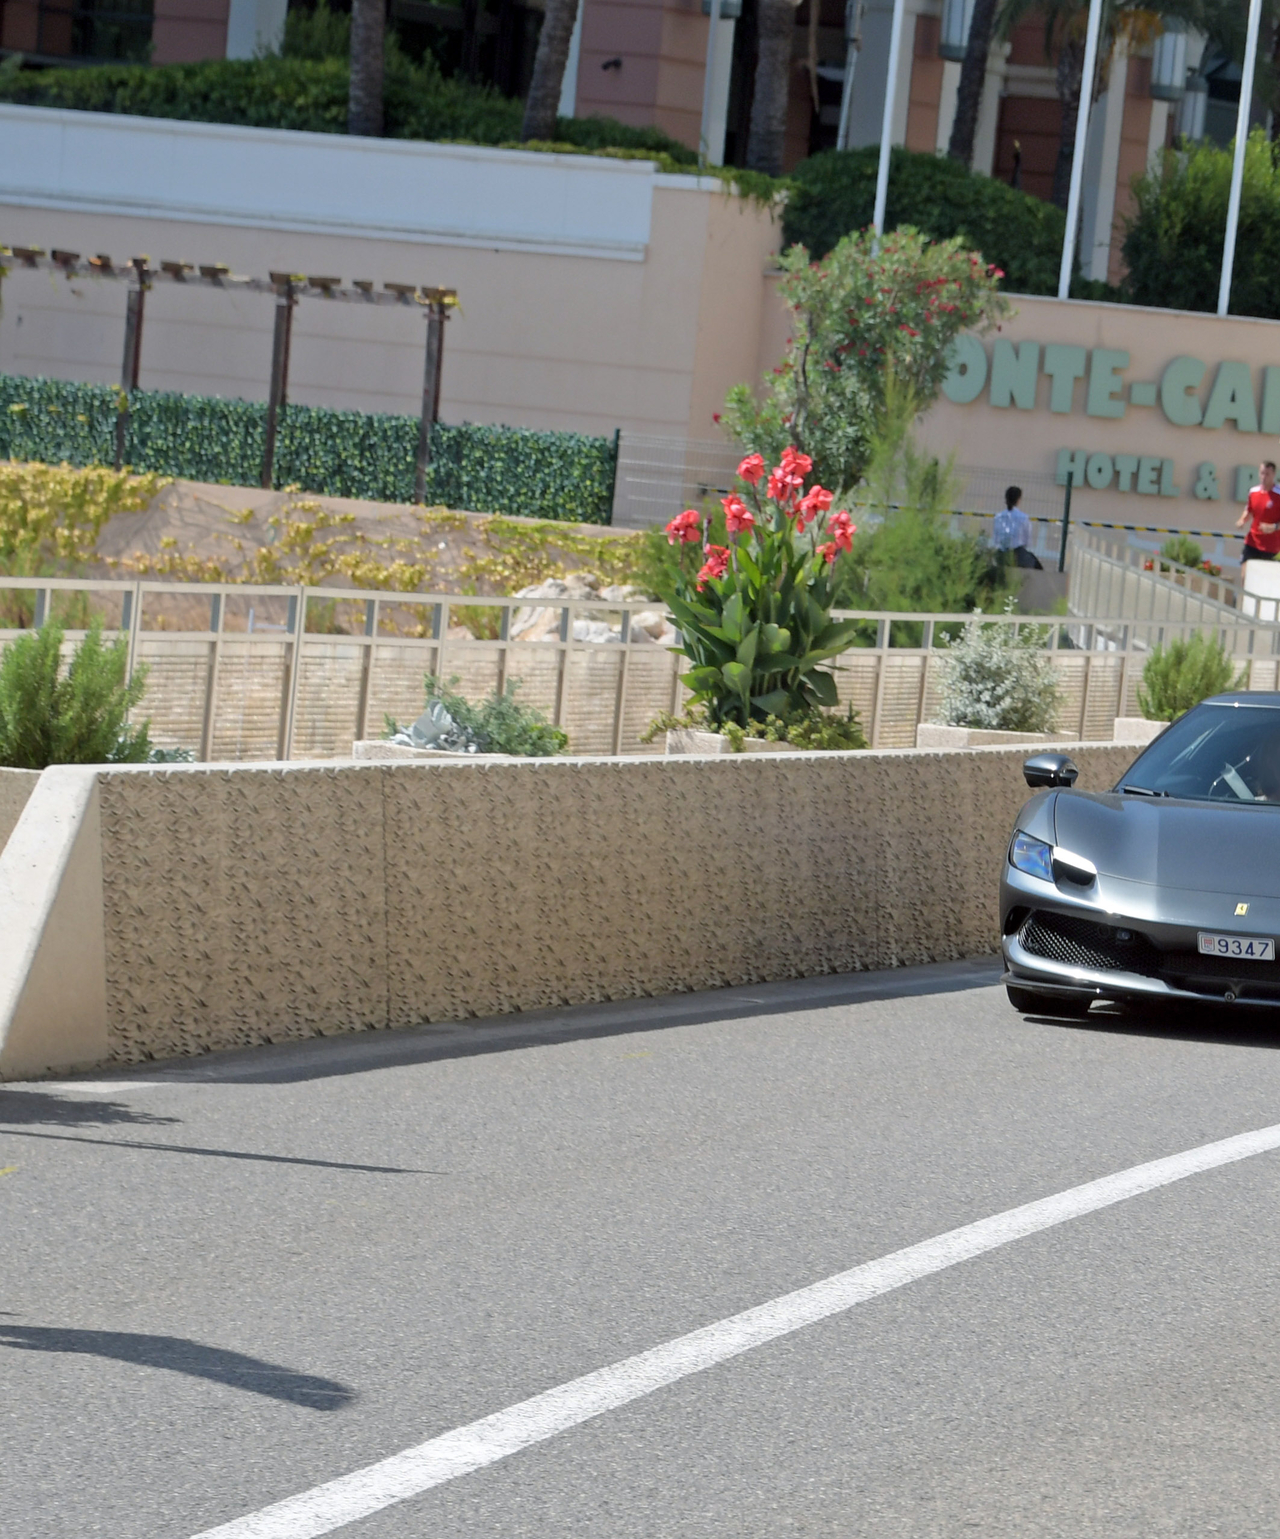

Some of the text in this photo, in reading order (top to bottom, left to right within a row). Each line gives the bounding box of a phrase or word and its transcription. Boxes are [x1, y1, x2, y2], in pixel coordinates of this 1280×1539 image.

[1056, 449, 1180, 498] HOTEL
[1194, 462, 1221, 500] &
[1217, 938, 1270, 957] 9347
